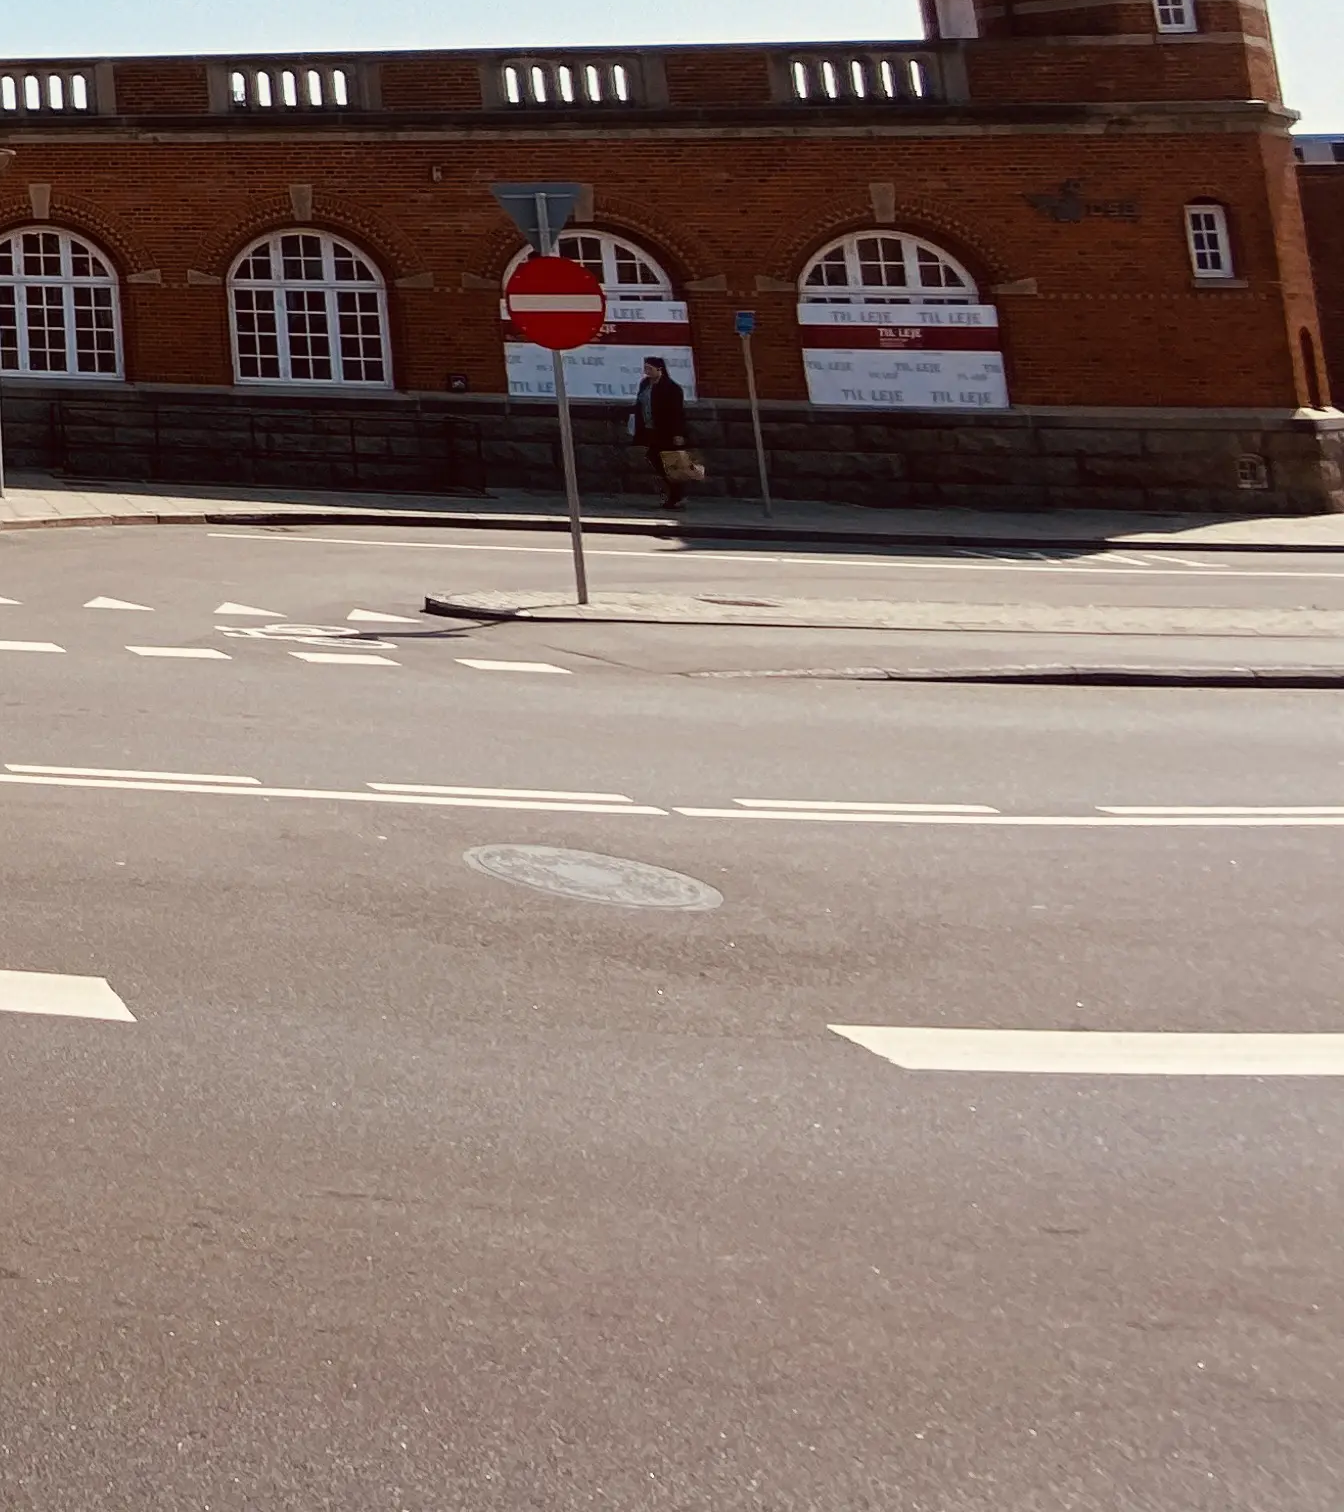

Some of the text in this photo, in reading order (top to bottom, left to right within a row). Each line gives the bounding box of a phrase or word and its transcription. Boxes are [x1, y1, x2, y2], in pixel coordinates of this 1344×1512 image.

[613, 308, 645, 320] LEJE
[830, 311, 892, 324] TIL LEJE
[917, 312, 982, 325] TIL LEJE
[877, 328, 922, 339] TIL LEJE
[510, 381, 554, 394] TIL LE
[593, 382, 639, 396] TIL LE
[841, 389, 904, 403] TIL LEJE
[930, 391, 993, 405] TIL LEJE
